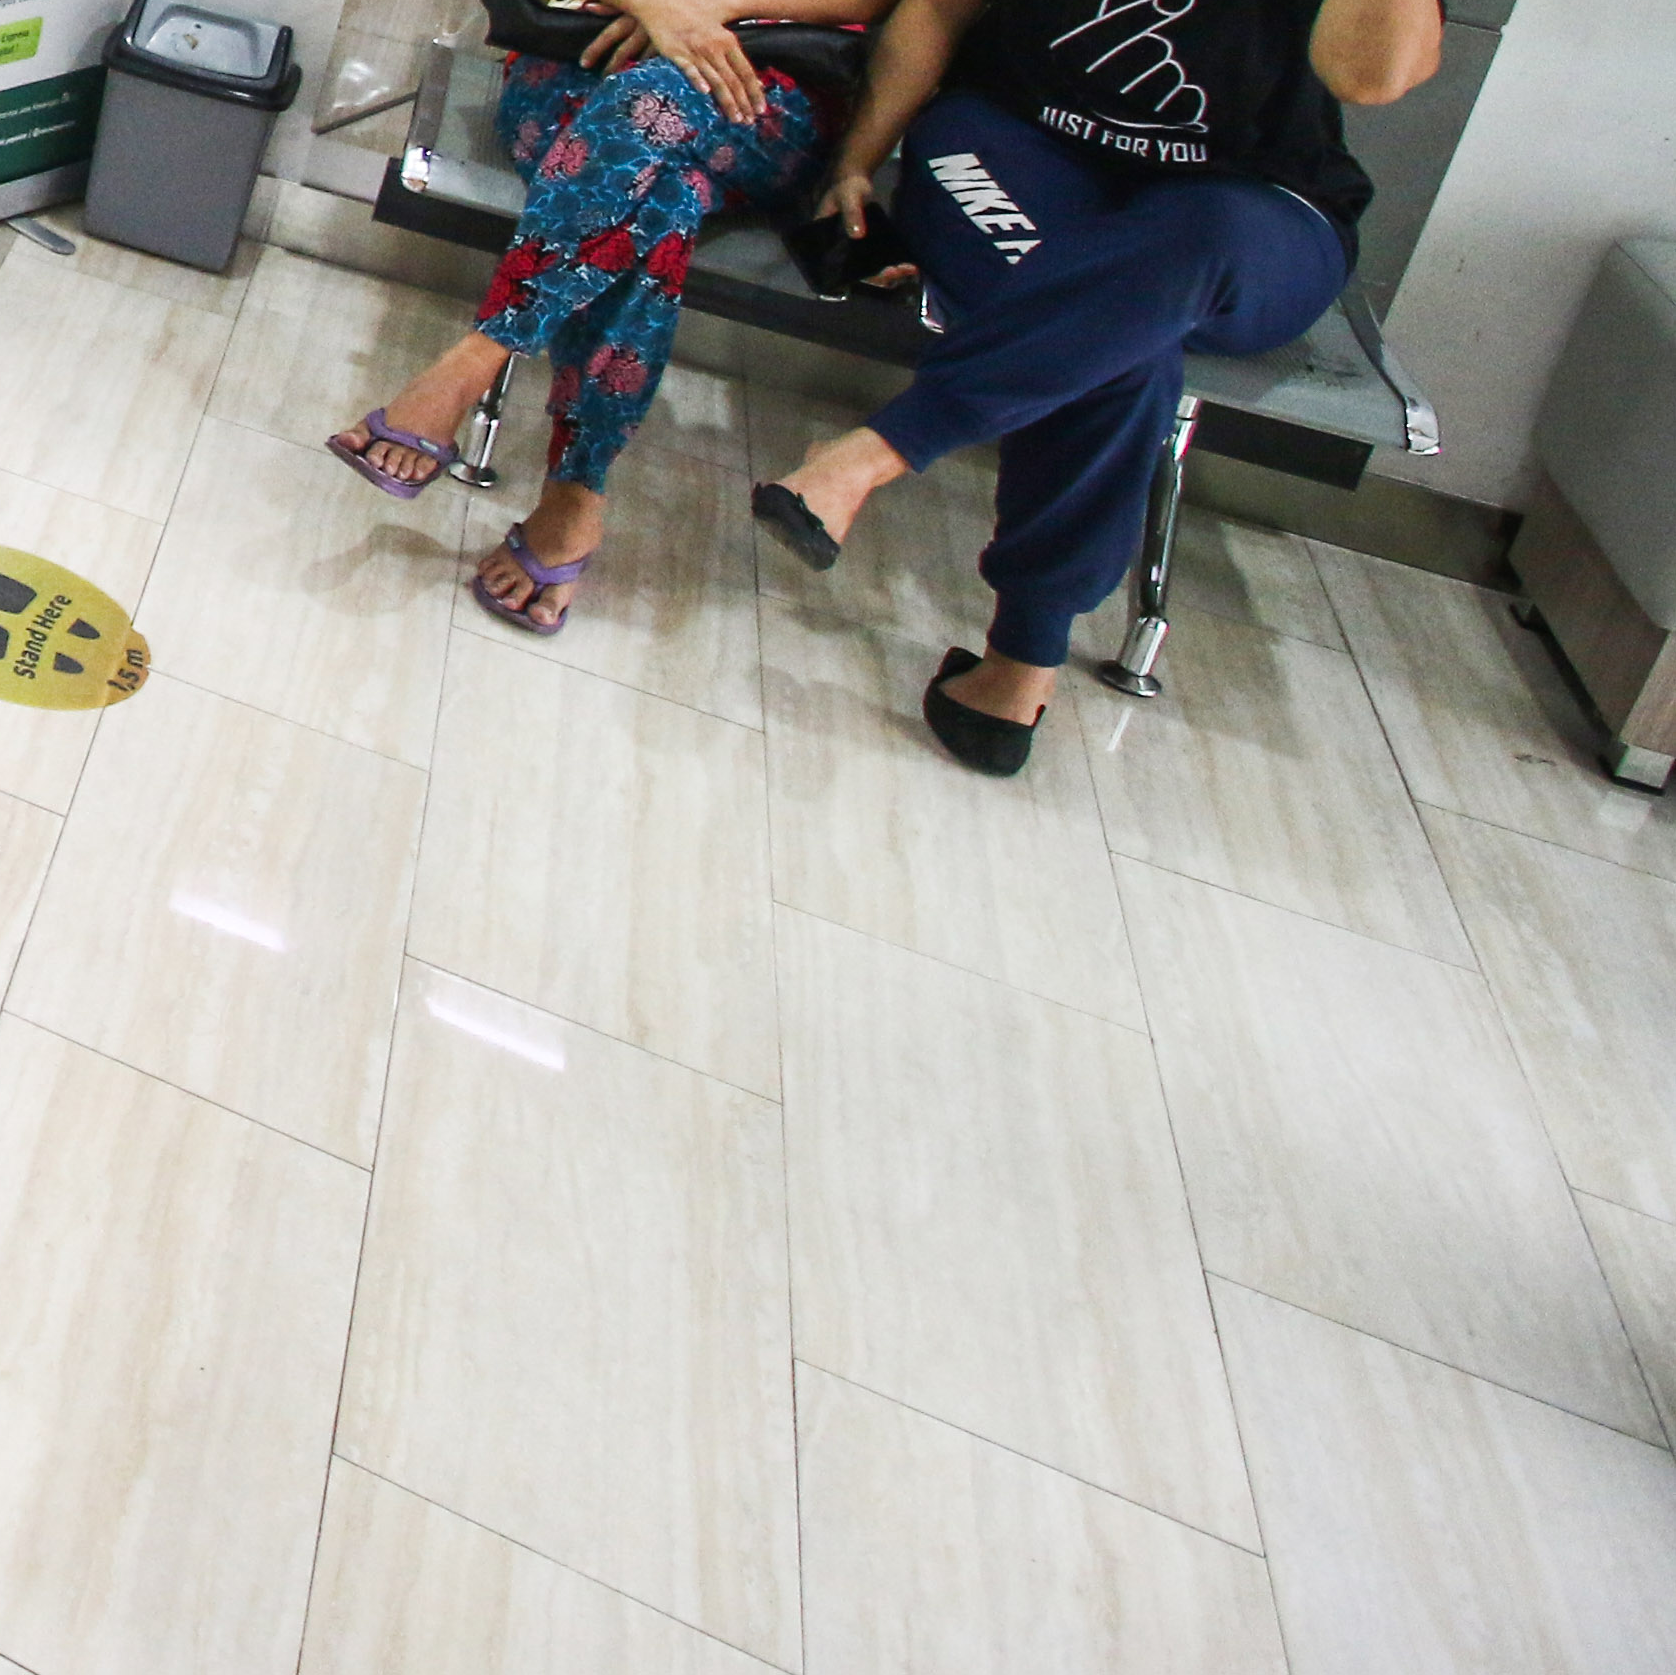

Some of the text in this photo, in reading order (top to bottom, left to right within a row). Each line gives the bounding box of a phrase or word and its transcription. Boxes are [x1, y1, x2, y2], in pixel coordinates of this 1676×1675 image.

[1039, 106, 1208, 163] JUST FOR YOU
[927, 153, 1037, 235] NIKE
[14, 593, 72, 680] Stand Here
[107, 648, 143, 693] 1,5 m
